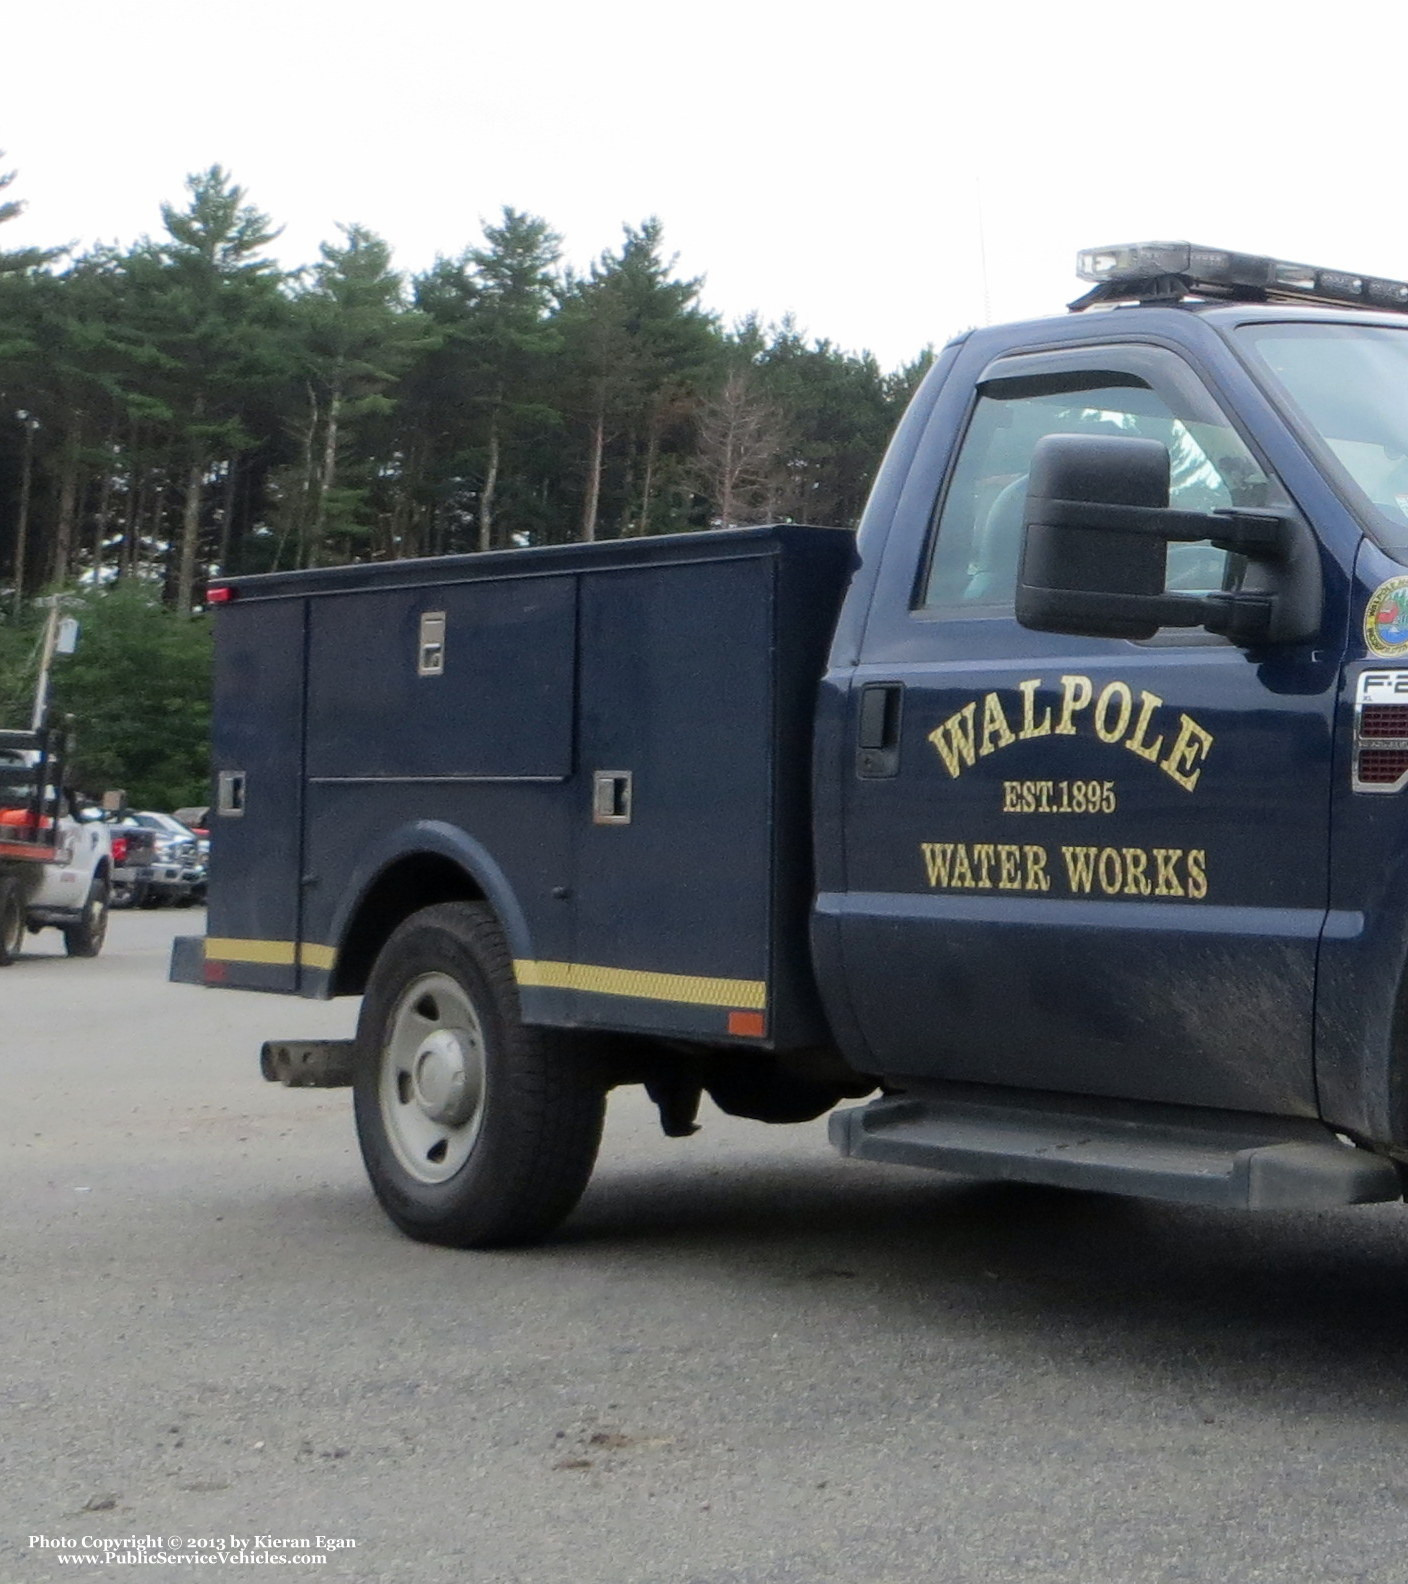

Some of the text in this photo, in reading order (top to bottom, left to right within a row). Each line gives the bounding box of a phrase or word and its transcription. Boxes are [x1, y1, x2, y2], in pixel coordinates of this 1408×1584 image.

[928, 675, 1215, 792] WALPOLE
[1003, 780, 1117, 813] EST.1895
[920, 843, 1209, 899] WATER WORKS
